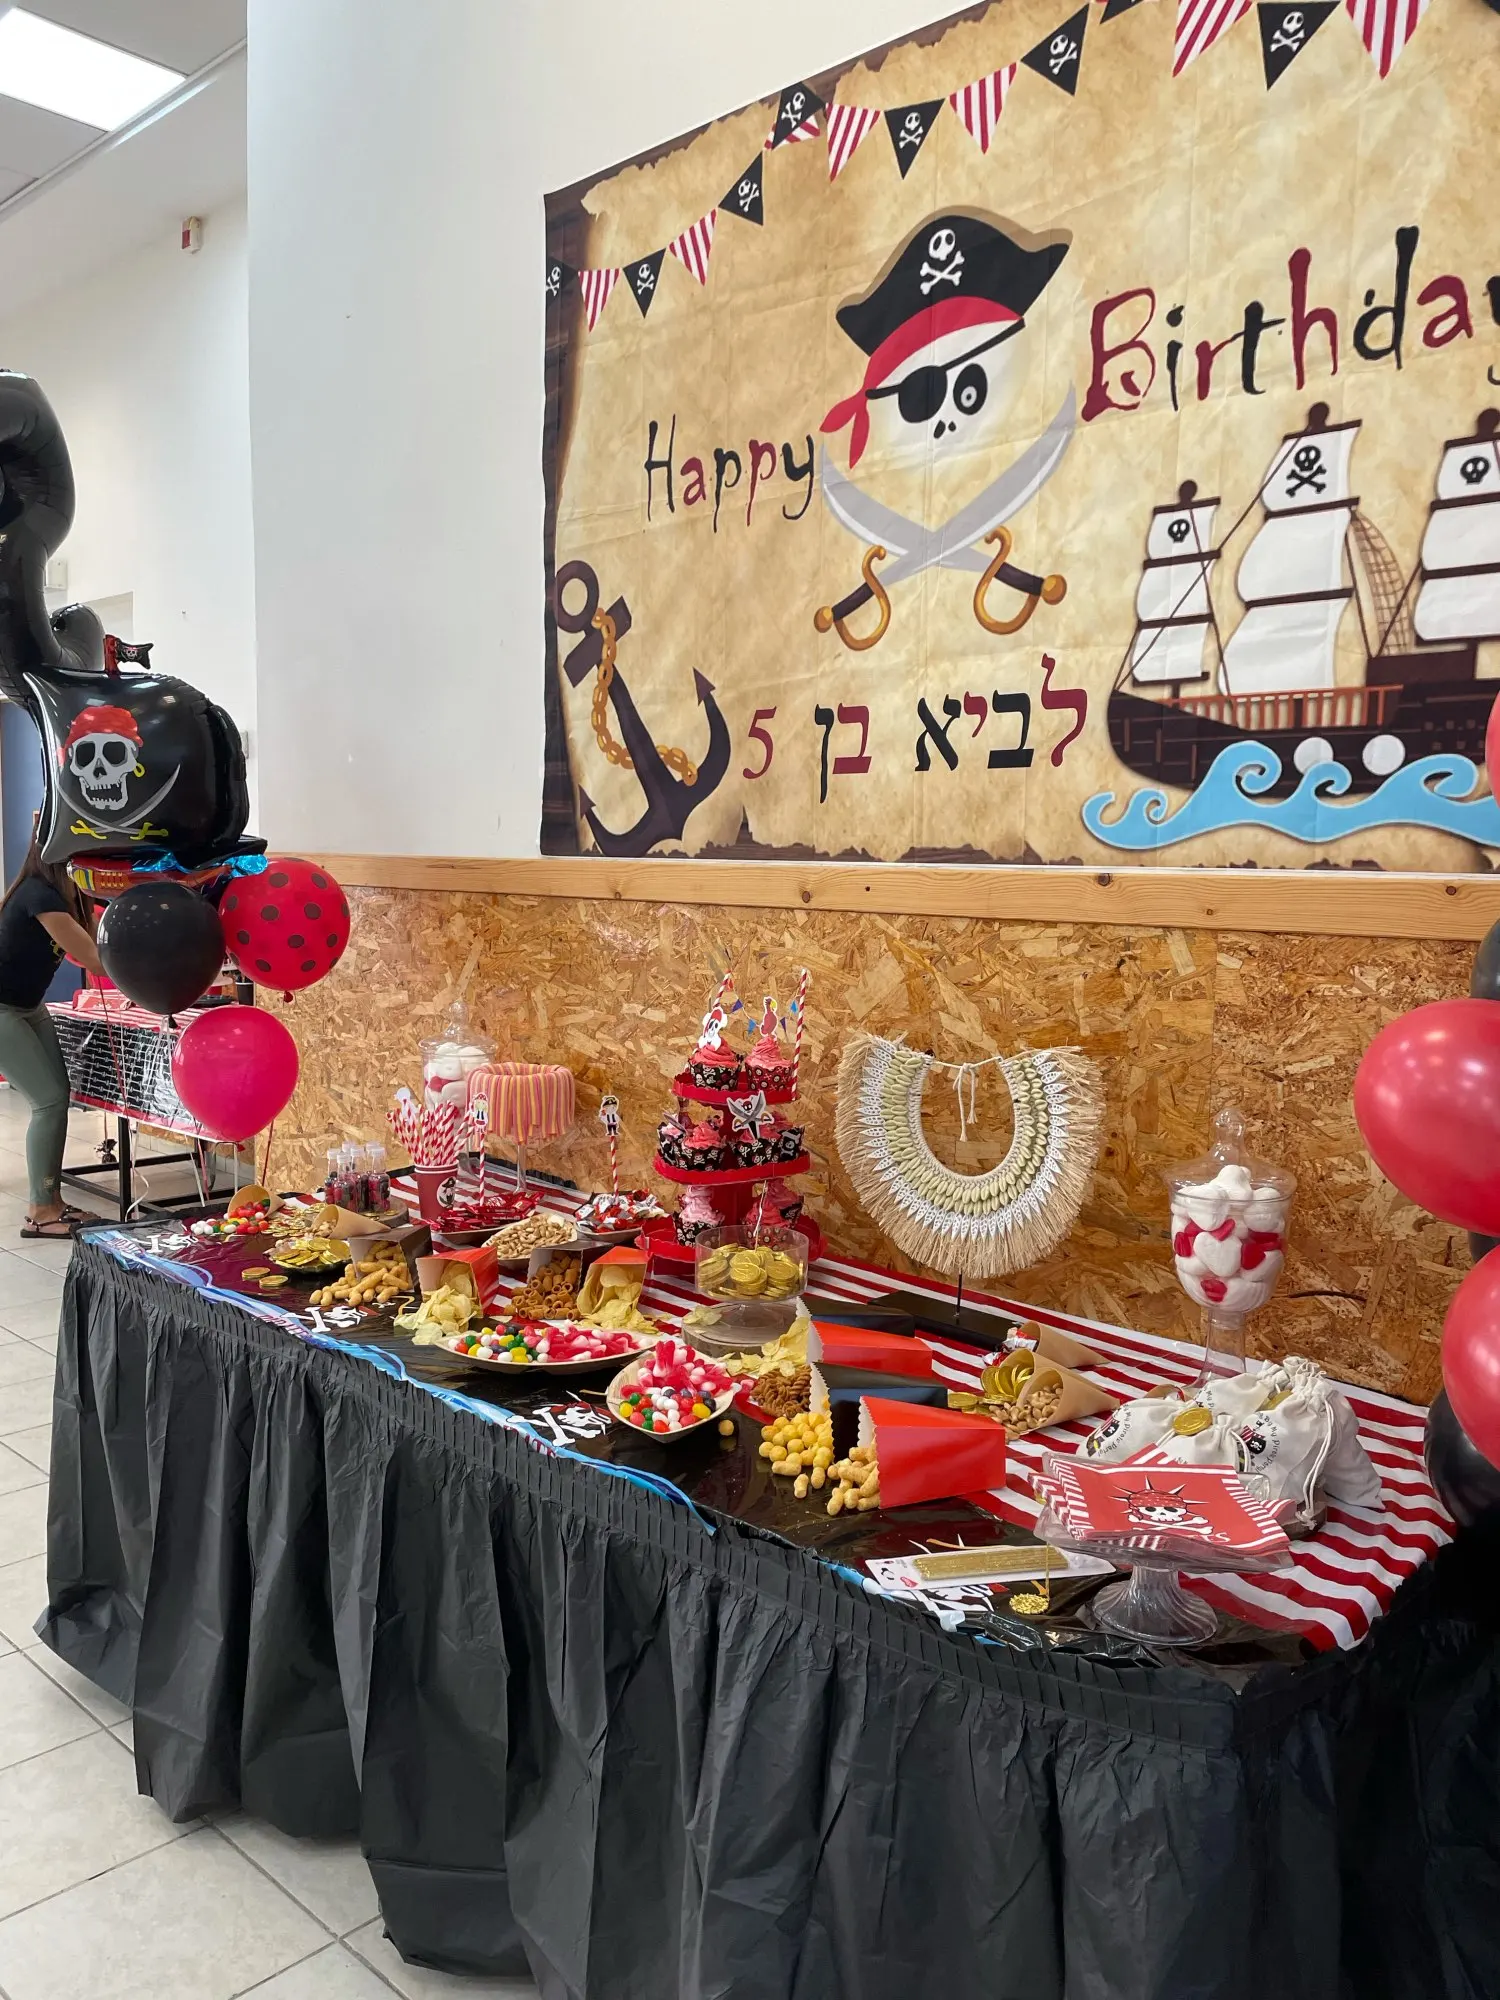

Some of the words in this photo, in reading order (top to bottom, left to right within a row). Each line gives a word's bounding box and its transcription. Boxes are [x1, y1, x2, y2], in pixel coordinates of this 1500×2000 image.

[644, 413, 815, 529] Happy
[1081, 225, 1500, 423] Birthda
[742, 705, 778, 780] 5
[814, 703, 872, 804] בן
[914, 653, 1088, 772] לביא
